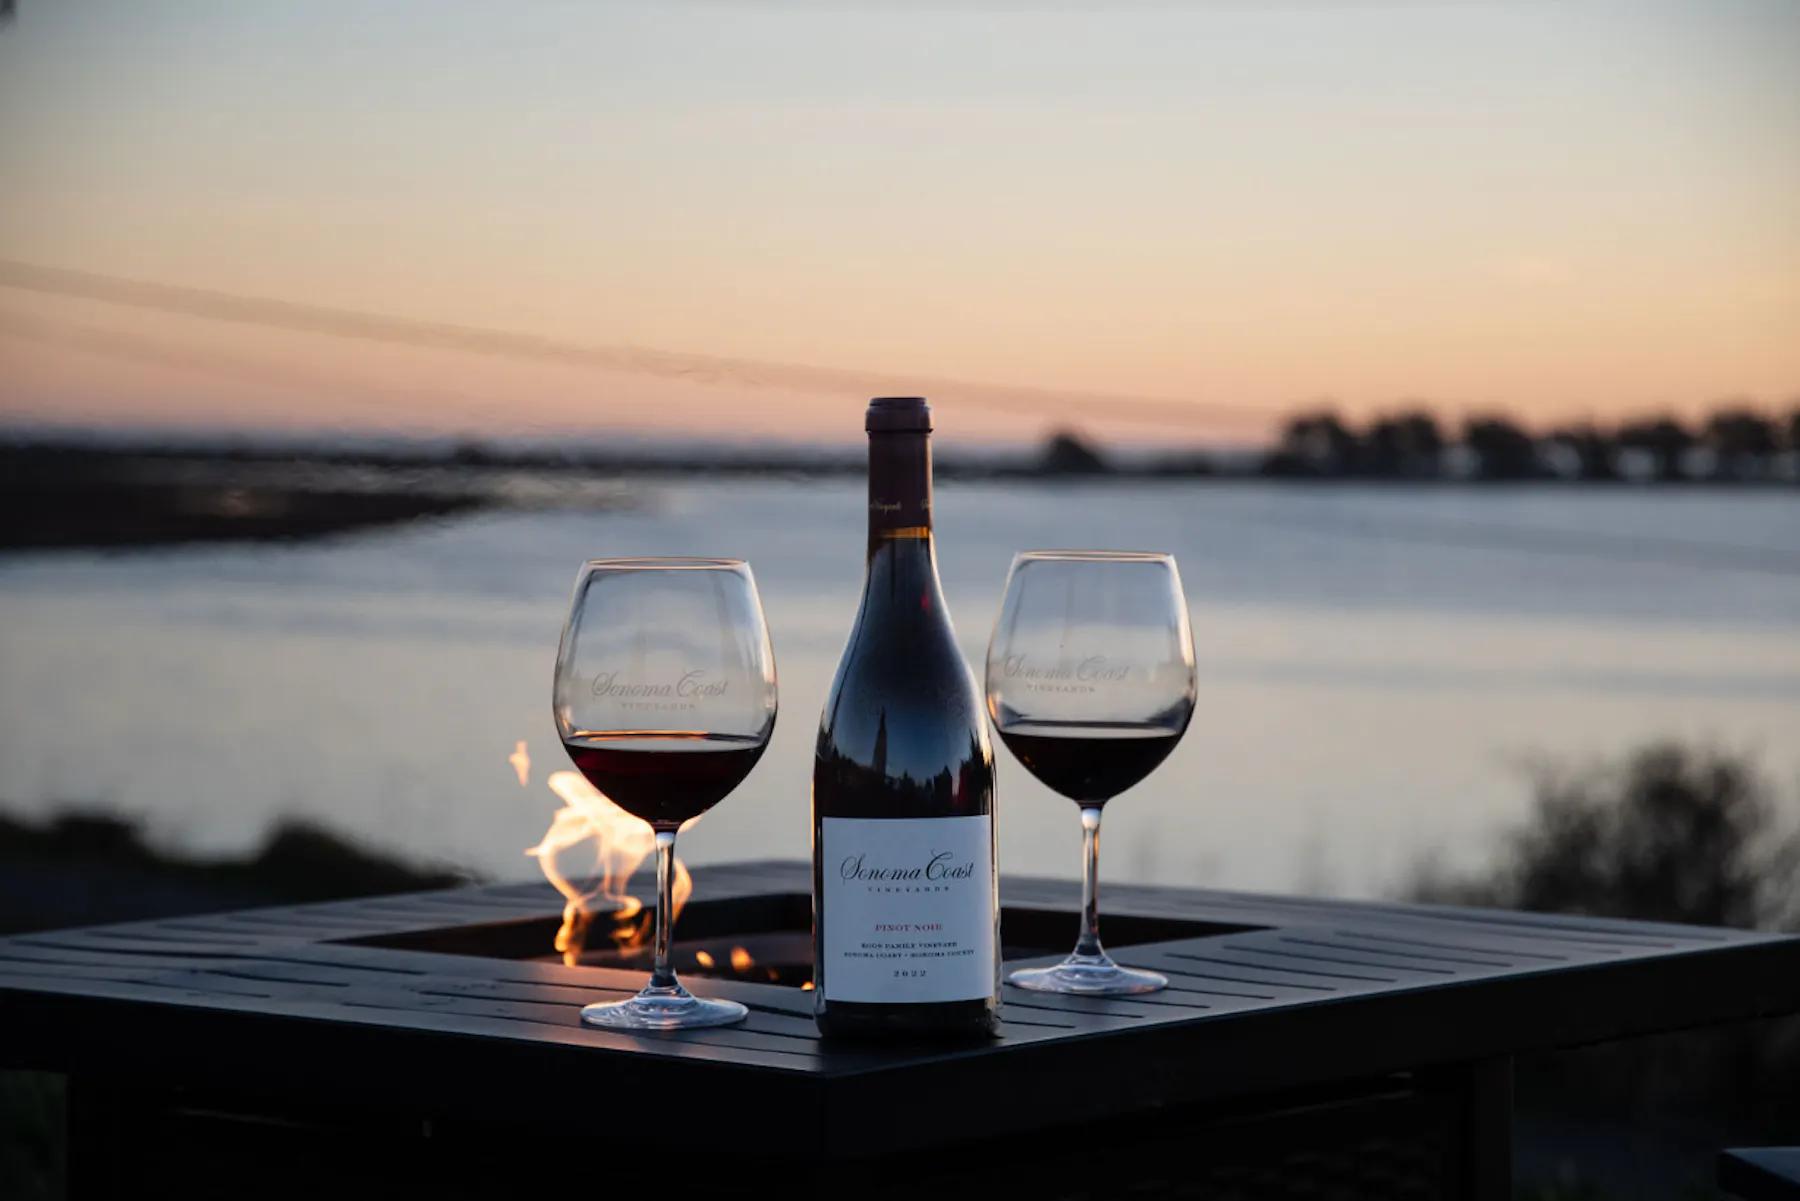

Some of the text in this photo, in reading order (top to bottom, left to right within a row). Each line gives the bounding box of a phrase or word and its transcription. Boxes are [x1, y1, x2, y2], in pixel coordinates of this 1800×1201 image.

[1077, 653, 1129, 682] Coast
[591, 665, 729, 700] Sonoma Coast
[840, 849, 974, 886] Sonoma Coast
[875, 923, 943, 932] PINOT NOIR
[947, 949, 975, 957] COUNTY
